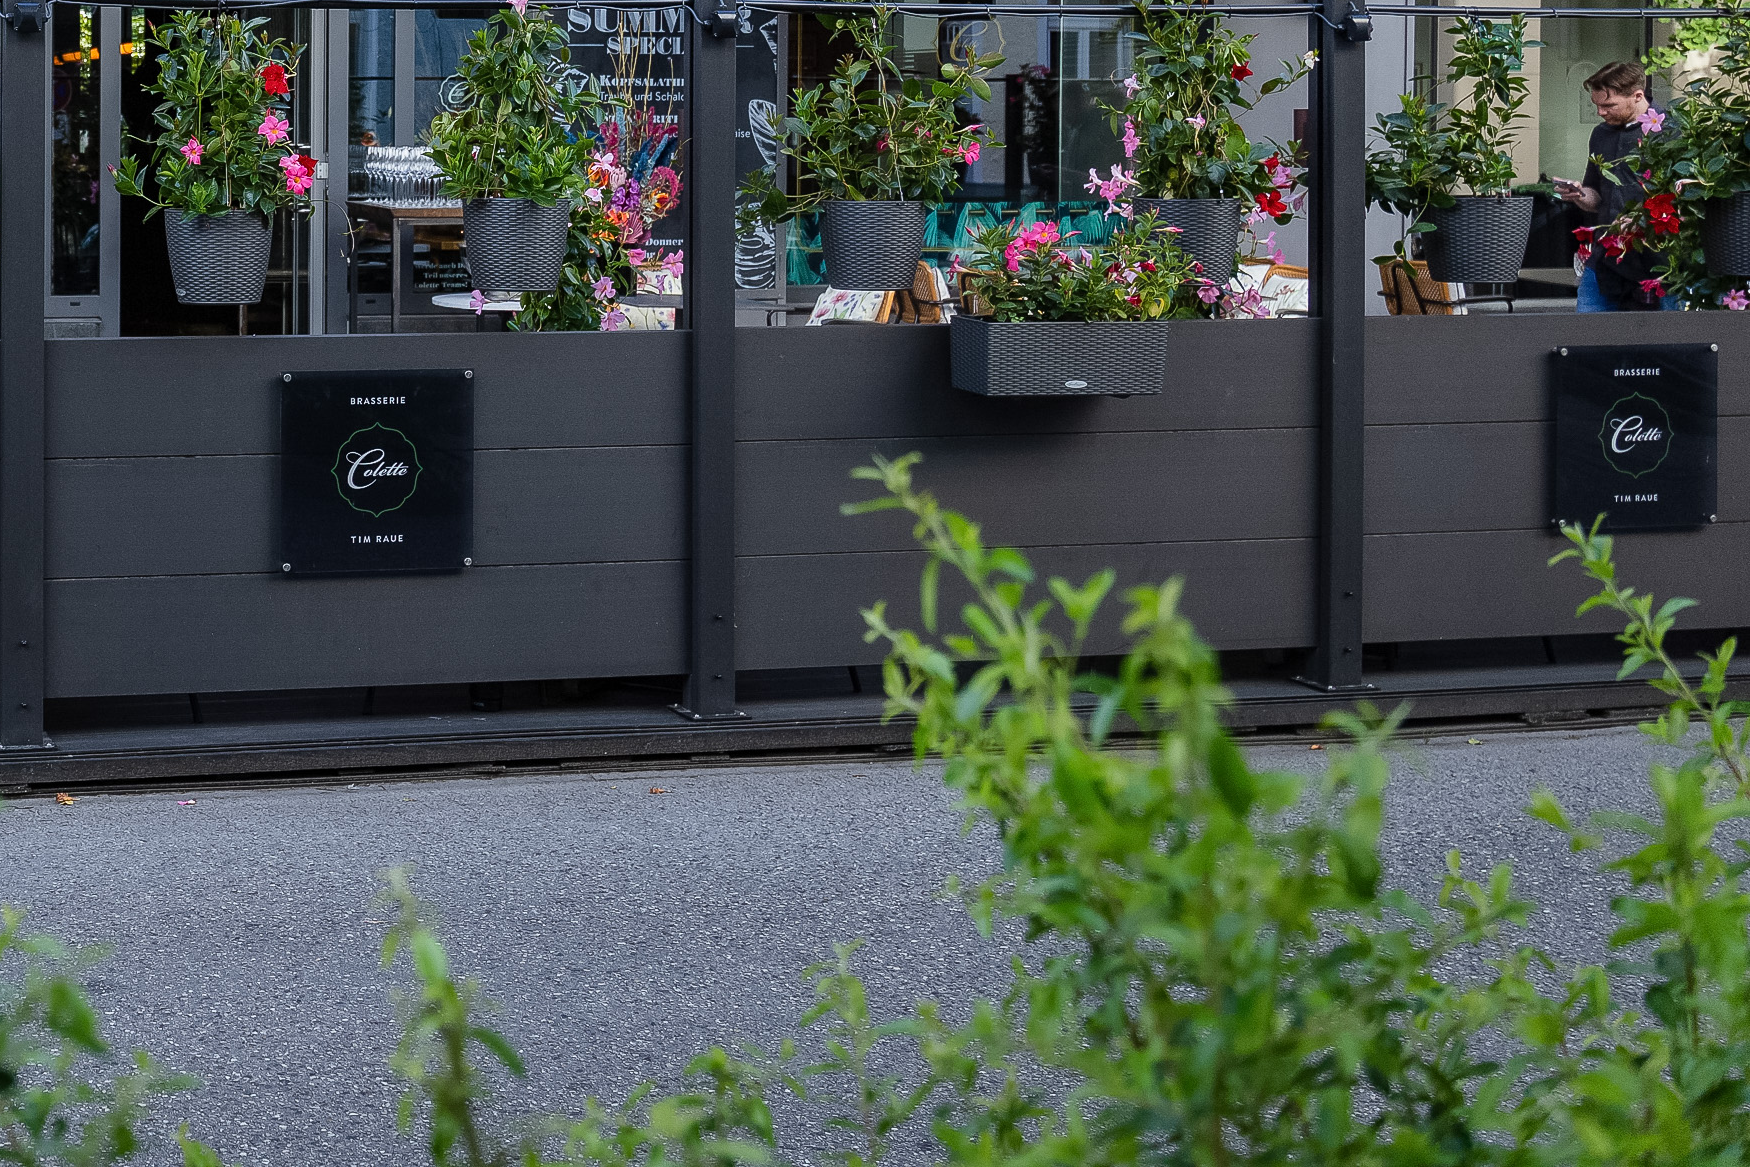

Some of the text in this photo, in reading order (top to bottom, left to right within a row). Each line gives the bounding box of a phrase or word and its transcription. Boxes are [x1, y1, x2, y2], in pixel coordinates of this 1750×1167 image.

[634, 91, 653, 101] und
[1614, 368, 1661, 377] BRASSERIE
[350, 396, 406, 405] BRASSERIE
[1609, 415, 1663, 454] Colette
[345, 448, 409, 490] Colette
[1614, 493, 1659, 503] TIM RAUE
[350, 534, 404, 544] TIM RAUE
